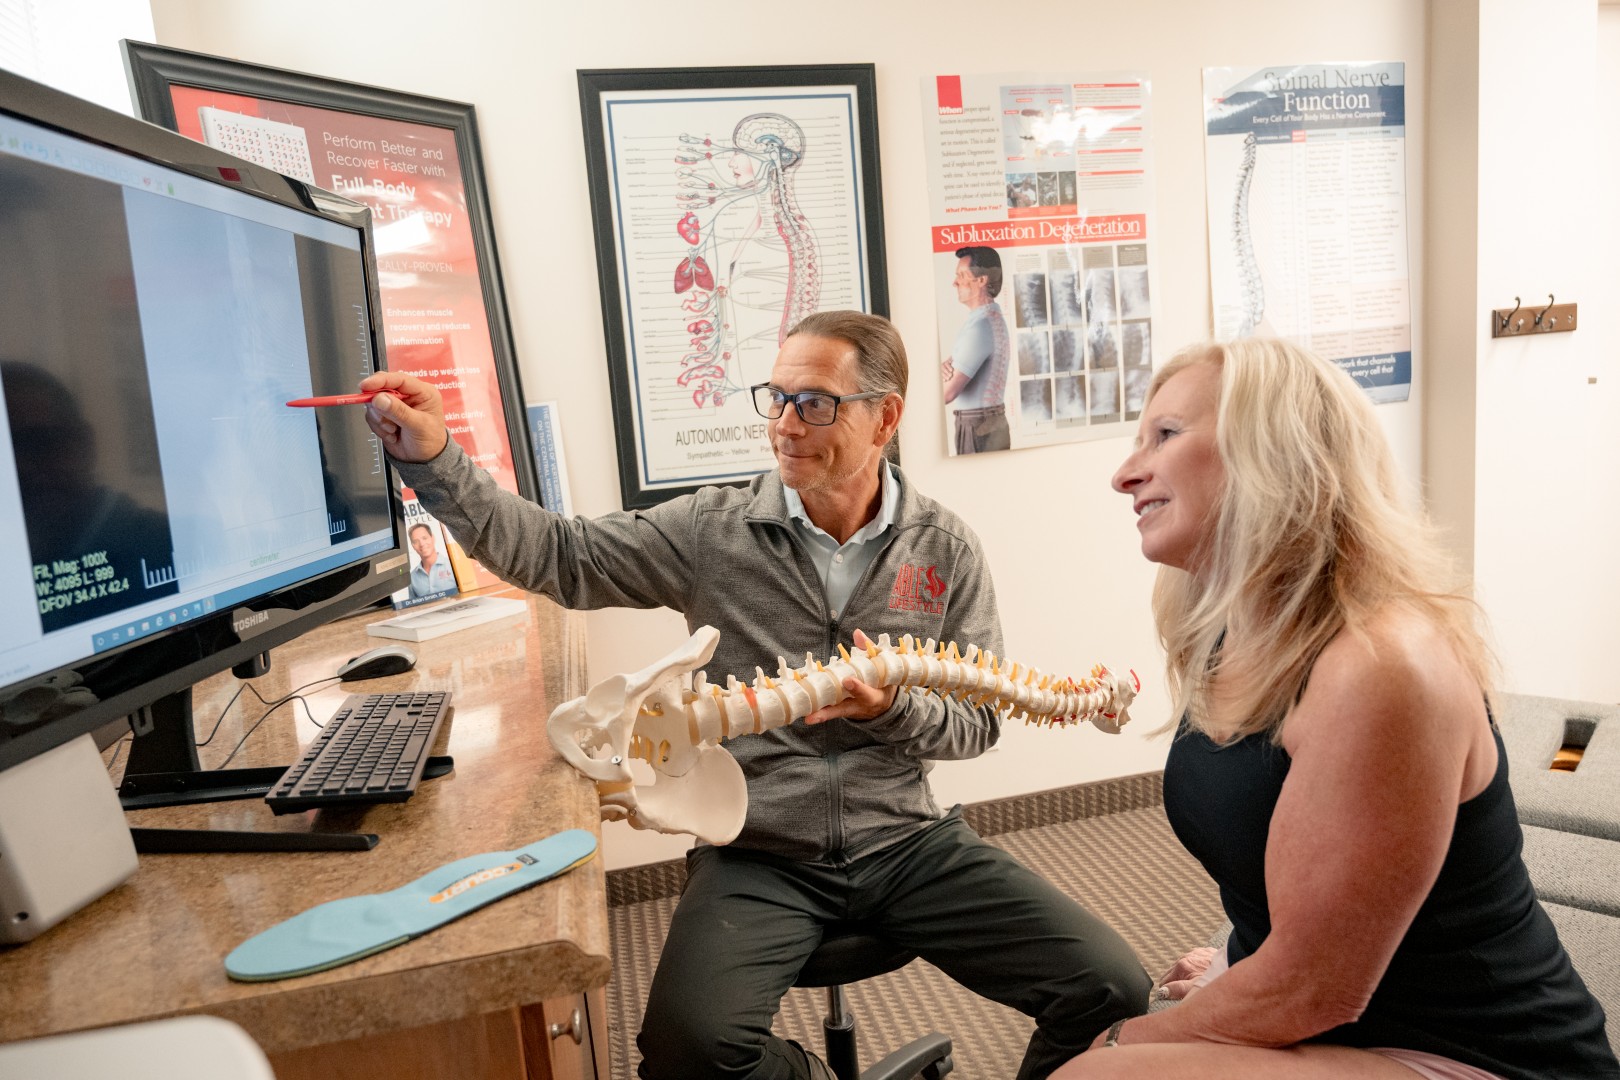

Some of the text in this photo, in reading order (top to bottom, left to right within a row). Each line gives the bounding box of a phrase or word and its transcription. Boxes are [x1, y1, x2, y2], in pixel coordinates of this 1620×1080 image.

[1264, 69, 1390, 92] Spinal Nerve
[1284, 91, 1370, 112] Function
[1252, 116, 1268, 124] Every
[1270, 114, 1282, 122] Cell
[1283, 114, 1290, 122] of
[1290, 113, 1302, 122] Your
[1304, 112, 1318, 122] Body
[1320, 112, 1330, 120] Has
[1336, 112, 1353, 120] Nerve
[1355, 110, 1386, 120] Component
[322, 131, 444, 160] Perform Better and
[326, 150, 446, 177] Recover Faster with
[331, 174, 416, 202] Full-Body
[940, 219, 1140, 245] Subluxation Degeneration
[376, 260, 454, 273] CALLY-PROVEN
[386, 308, 454, 317] Enhances muscle
[390, 322, 471, 332] recovery and reduces
[392, 336, 444, 346] inflammation
[1356, 358, 1368, 366] that
[1370, 354, 1396, 366] channels
[429, 370, 439, 378] up
[440, 366, 466, 378] weight
[466, 366, 480, 374] loss
[1352, 370, 1368, 378] every
[1370, 366, 1380, 375] cell
[434, 381, 467, 390] eduction
[445, 412, 460, 421] skin
[675, 424, 768, 447] AUTONOMIC NER
[545, 421, 554, 452] EFFECTS
[551, 462, 562, 502] VERTEBRAL
[687, 450, 724, 461] Sympathetic
[731, 448, 750, 456] Yellow
[537, 420, 543, 431] ON
[541, 447, 550, 477] CENTRAL
[546, 479, 555, 510] NERVOUS
[53, 558, 80, 574] Mag:
[82, 551, 108, 568] 100X
[250, 552, 280, 568] centimeter
[36, 566, 114, 596] W: 4095 L: 999
[39, 578, 130, 614] DFOV 34.4 X 42.4
[889, 598, 944, 614] LIFESTYLE
[233, 610, 270, 633] TOSHIBA
